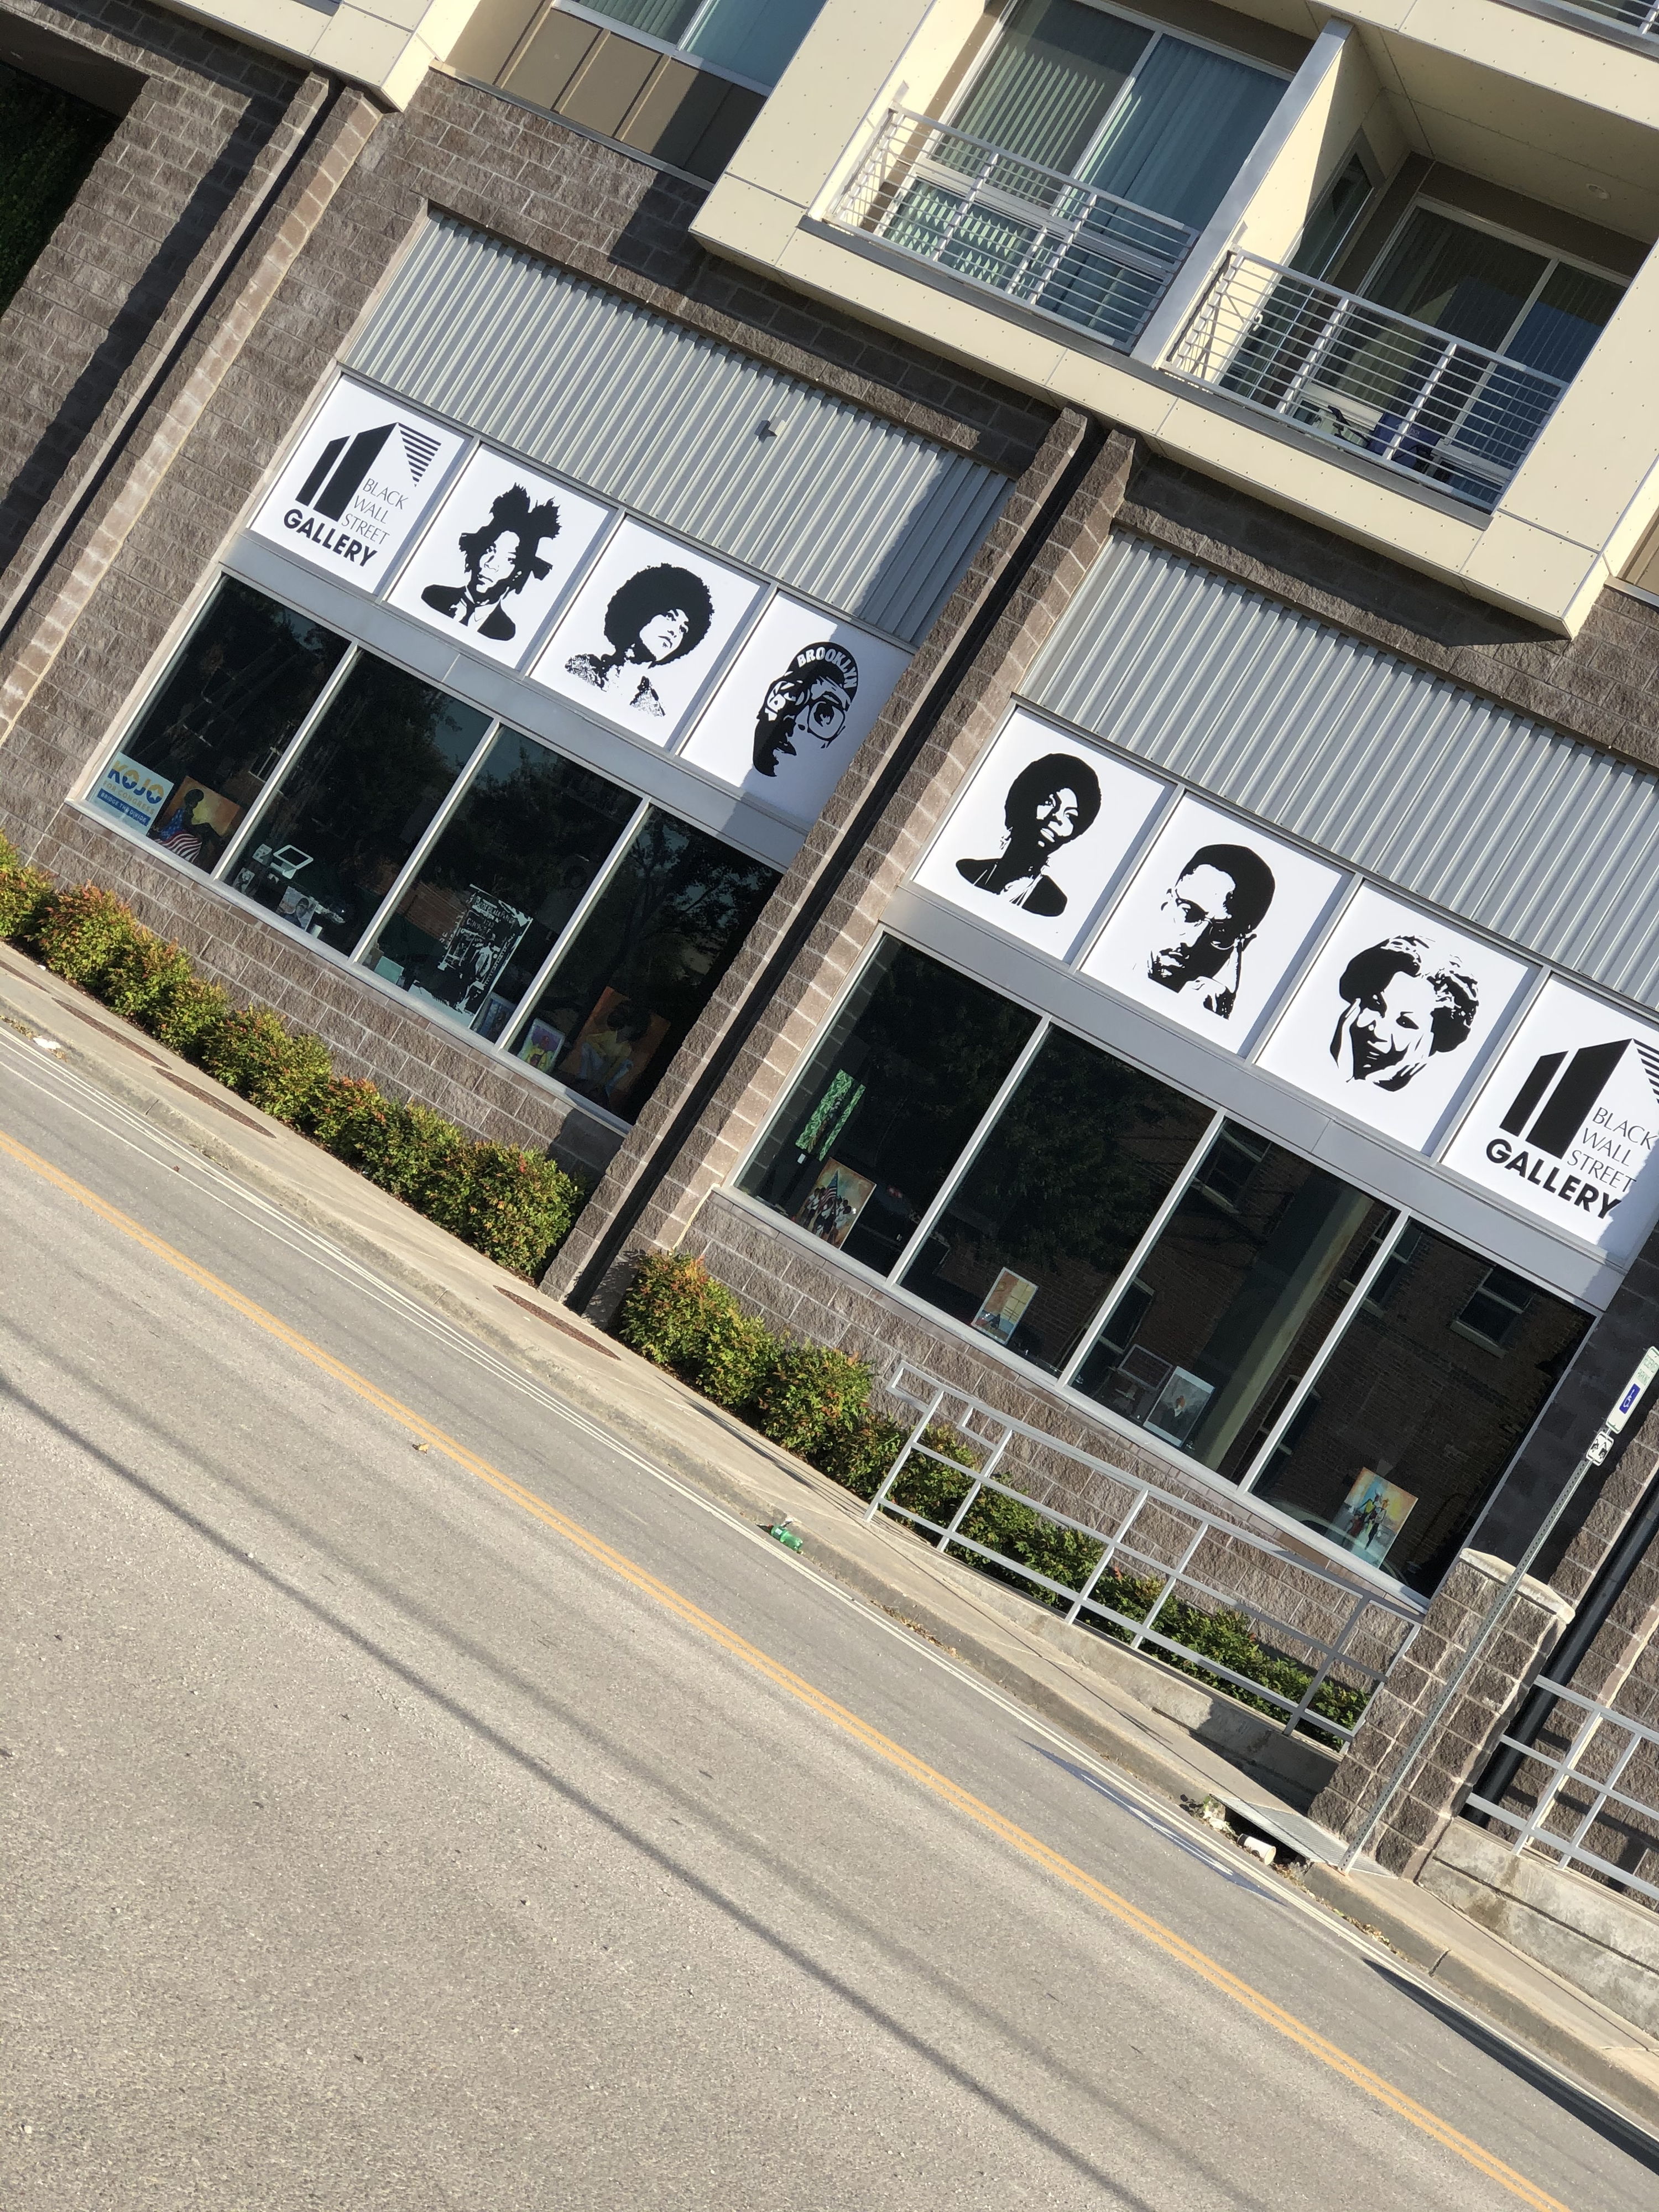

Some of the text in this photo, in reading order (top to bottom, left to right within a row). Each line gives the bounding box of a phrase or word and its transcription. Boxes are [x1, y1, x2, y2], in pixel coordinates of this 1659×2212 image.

[353, 495, 388, 524] WALL
[363, 478, 409, 510] BLACK
[284, 509, 378, 567] GALLERY
[341, 514, 390, 545] STREET
[796, 647, 858, 688] BROOKLYN
[101, 792, 118, 805] BRIDGE
[103, 781, 155, 815] FOR CONGRESS
[107, 760, 164, 804] KOJO
[1582, 1128, 1632, 1167] WALL
[1592, 1107, 1658, 1150] BLACK
[1486, 1138, 1622, 1219] GALLERY
[1567, 1150, 1637, 1192] STREET
